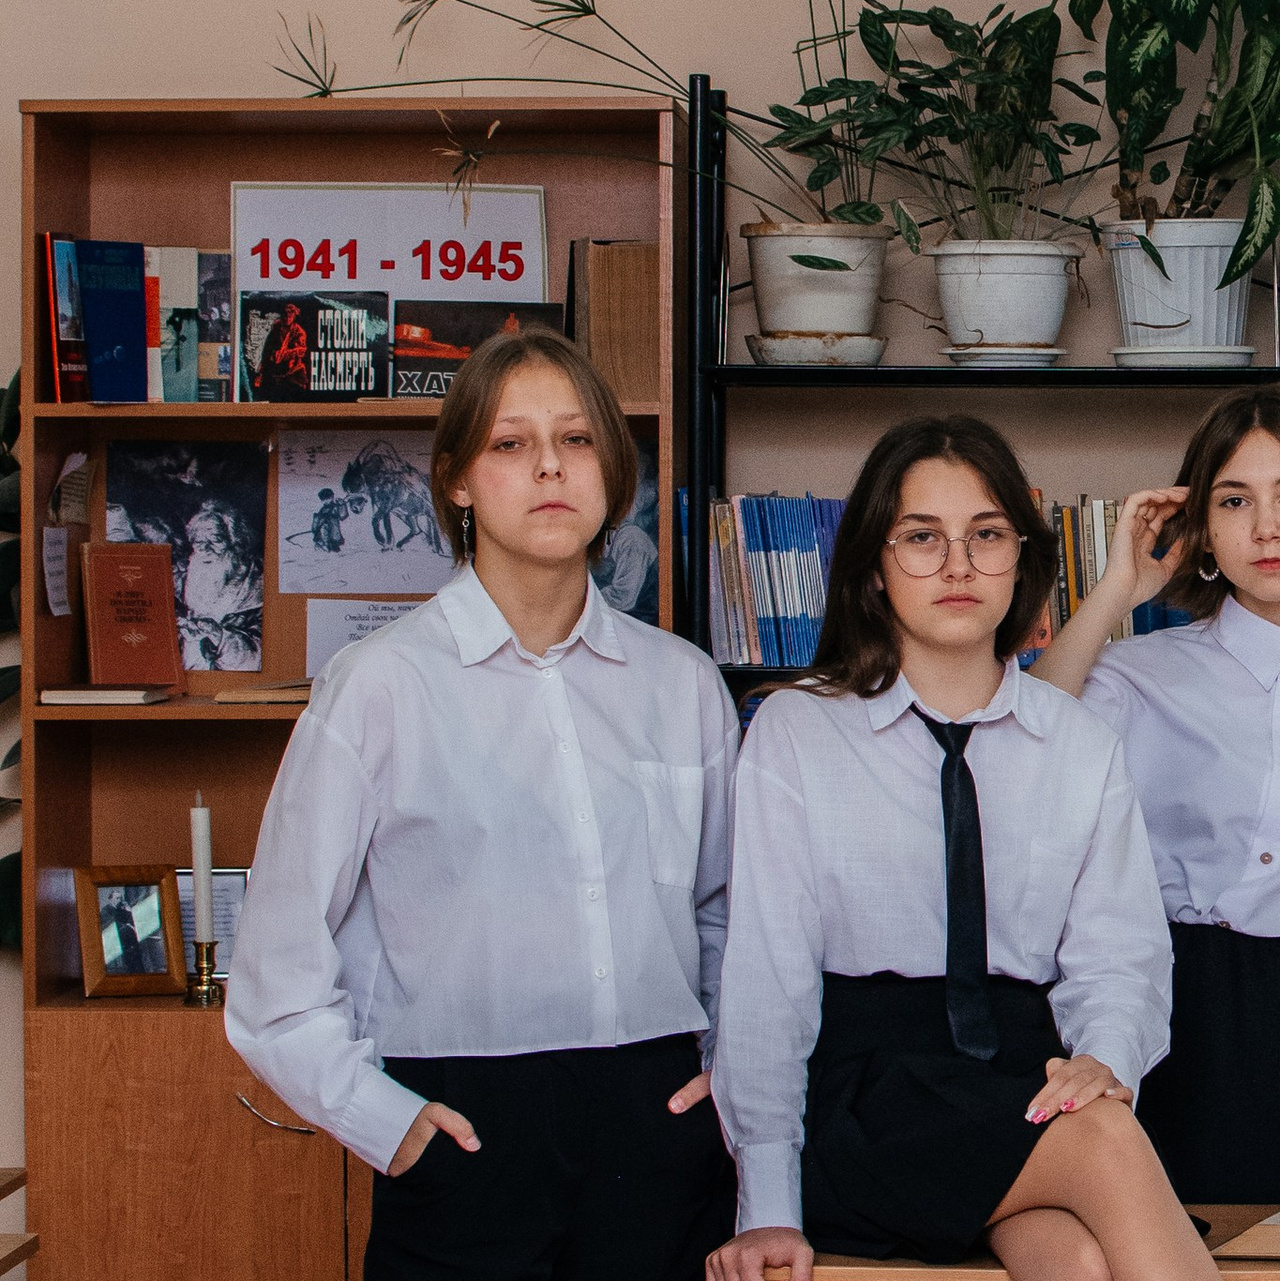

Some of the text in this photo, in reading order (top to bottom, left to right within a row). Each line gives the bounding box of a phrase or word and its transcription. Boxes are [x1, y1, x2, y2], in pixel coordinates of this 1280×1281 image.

[251, 238, 525, 282] 1941 - 1945
[318, 309, 368, 349] СТОЯЛИ
[310, 352, 375, 391] НАСМЕРТЬ
[345, 614, 370, 622] Отдай
